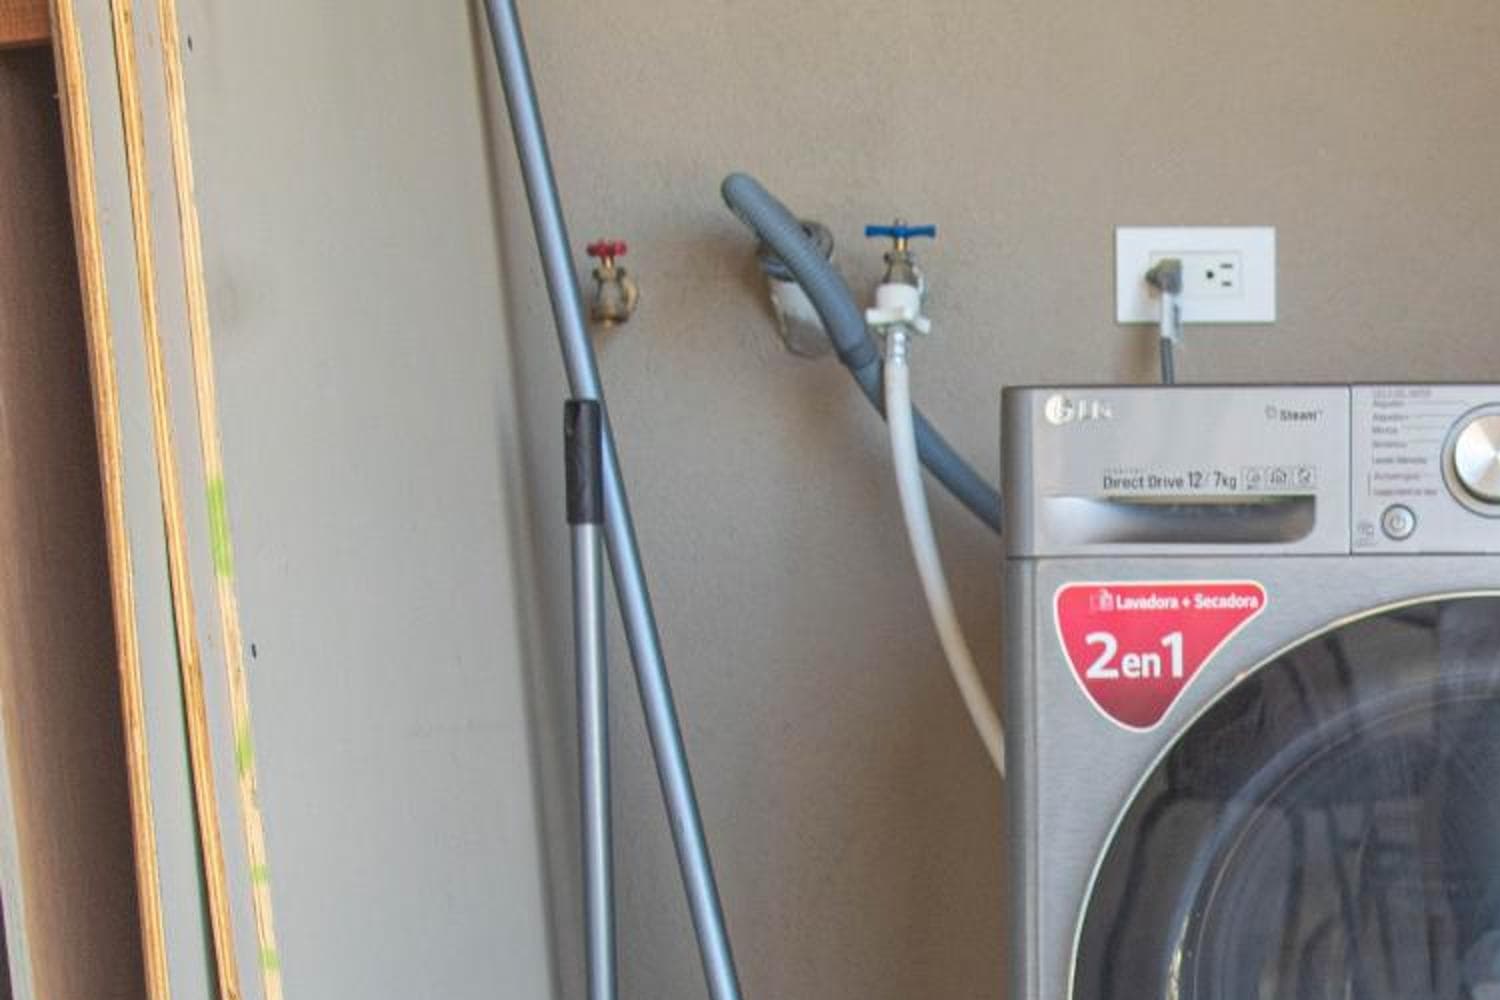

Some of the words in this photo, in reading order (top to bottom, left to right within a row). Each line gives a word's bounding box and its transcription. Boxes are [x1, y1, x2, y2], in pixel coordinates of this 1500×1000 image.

[1103, 474, 1144, 490] Direct
[1147, 475, 1184, 489] Drive
[1116, 594, 1178, 609] Lavadora
[1194, 592, 1258, 608] Secadora
